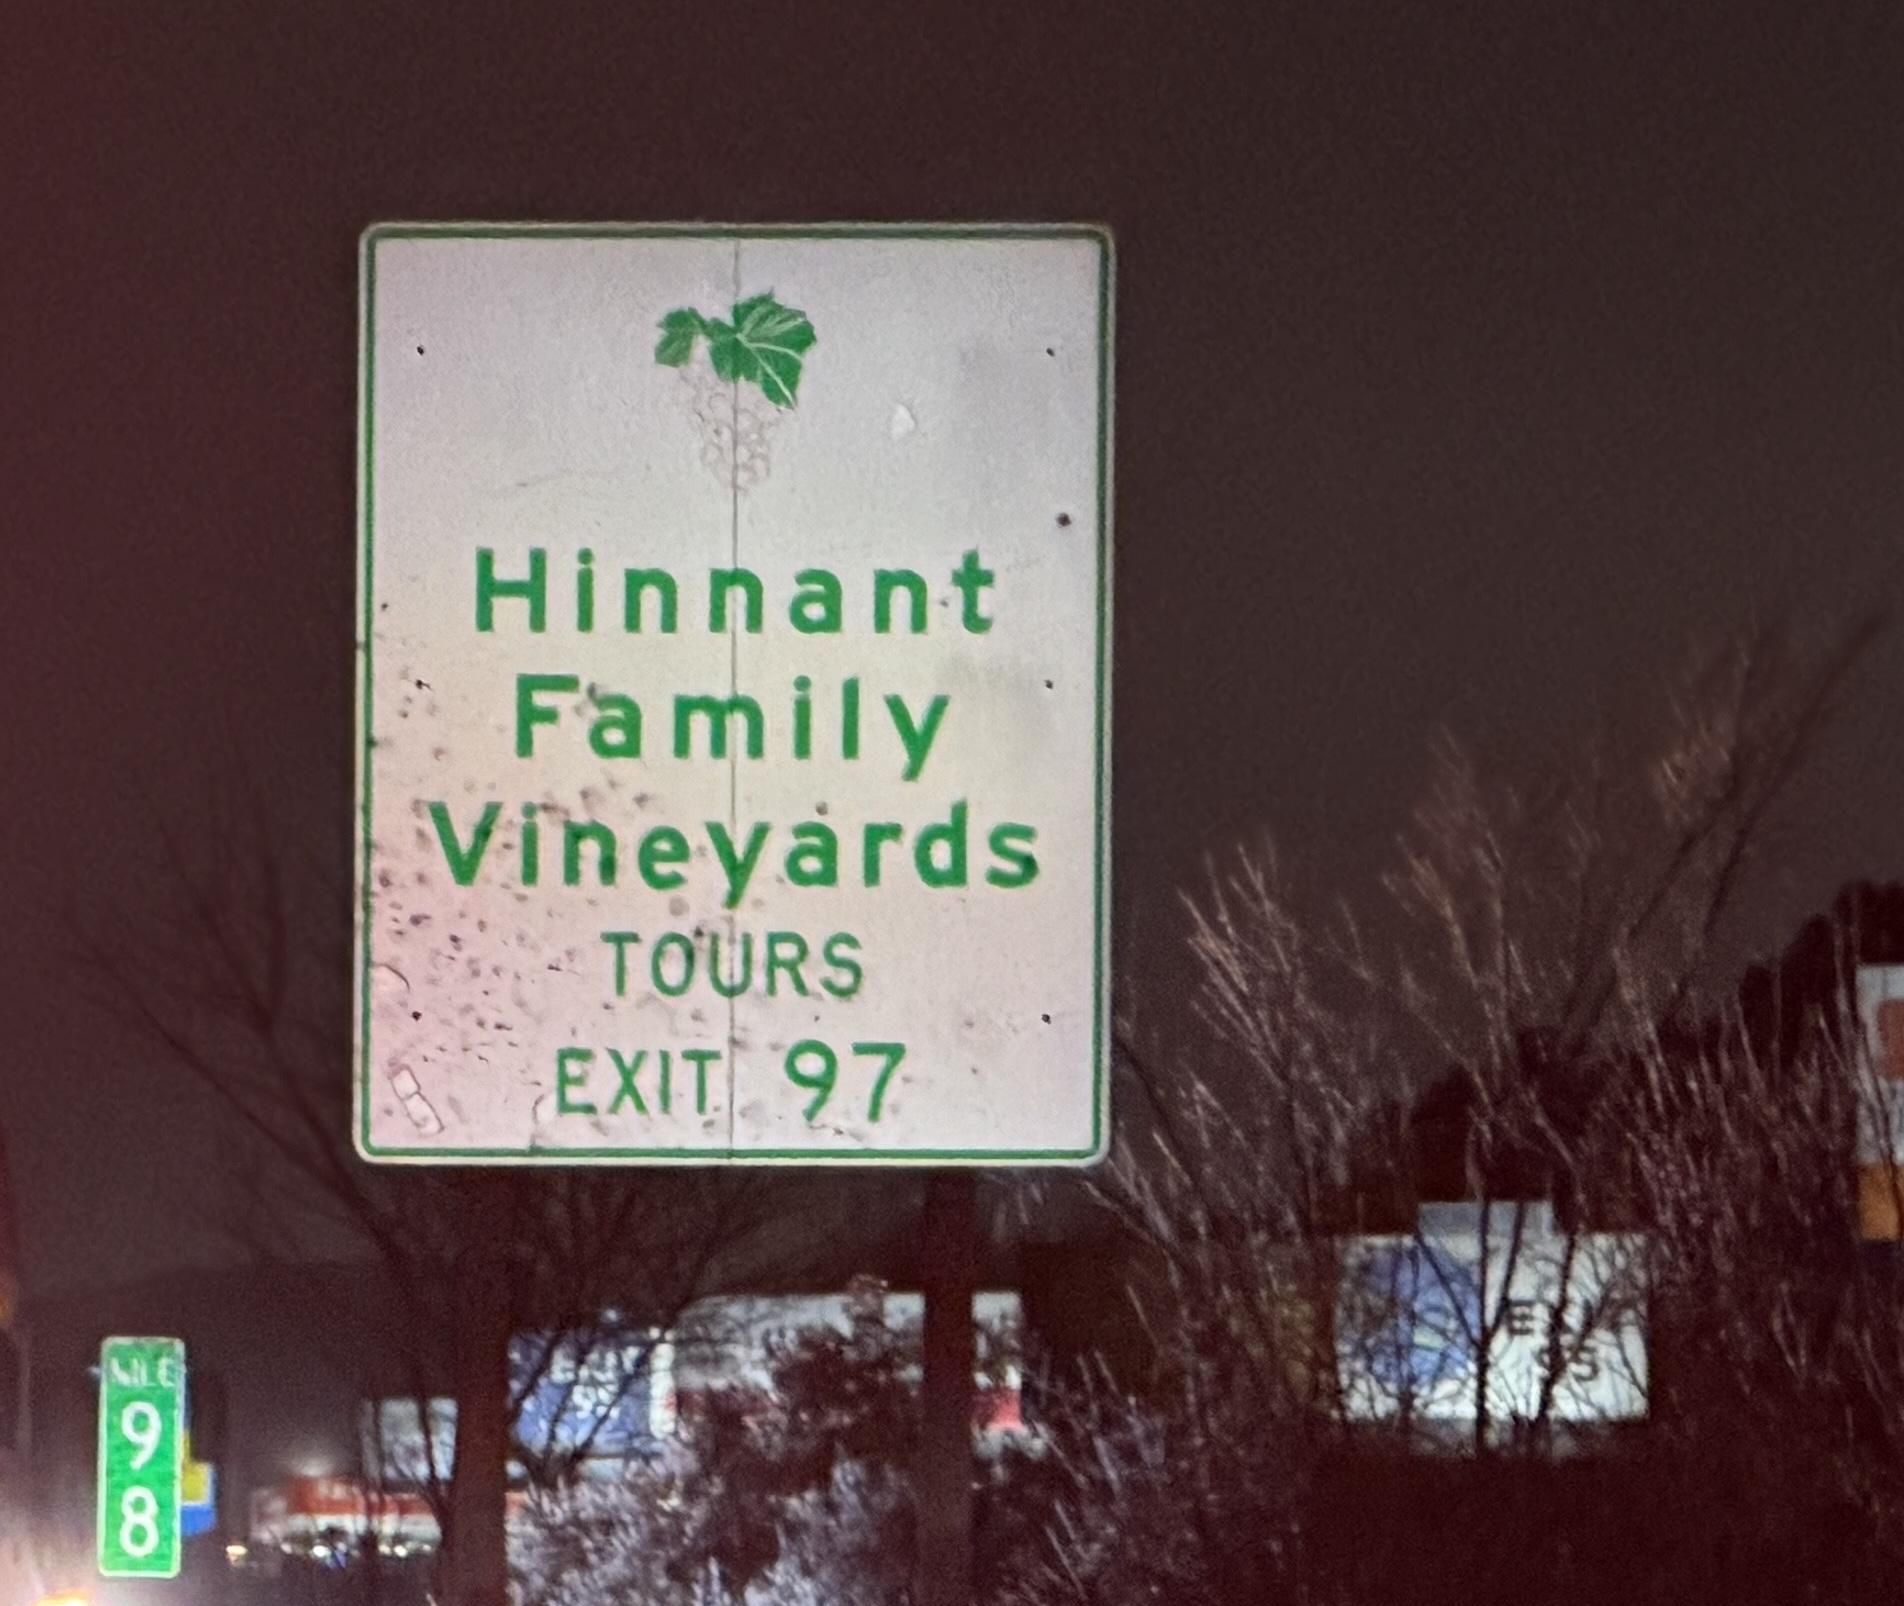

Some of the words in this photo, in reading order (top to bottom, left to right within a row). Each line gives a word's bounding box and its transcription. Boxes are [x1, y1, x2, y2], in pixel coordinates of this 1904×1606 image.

[475, 546, 995, 636] Hinnant
[514, 672, 950, 782] Family
[428, 801, 1040, 908] Vineyards
[600, 930, 864, 998] TOURS
[555, 1047, 723, 1115] EXIT
[783, 1038, 907, 1123] 97
